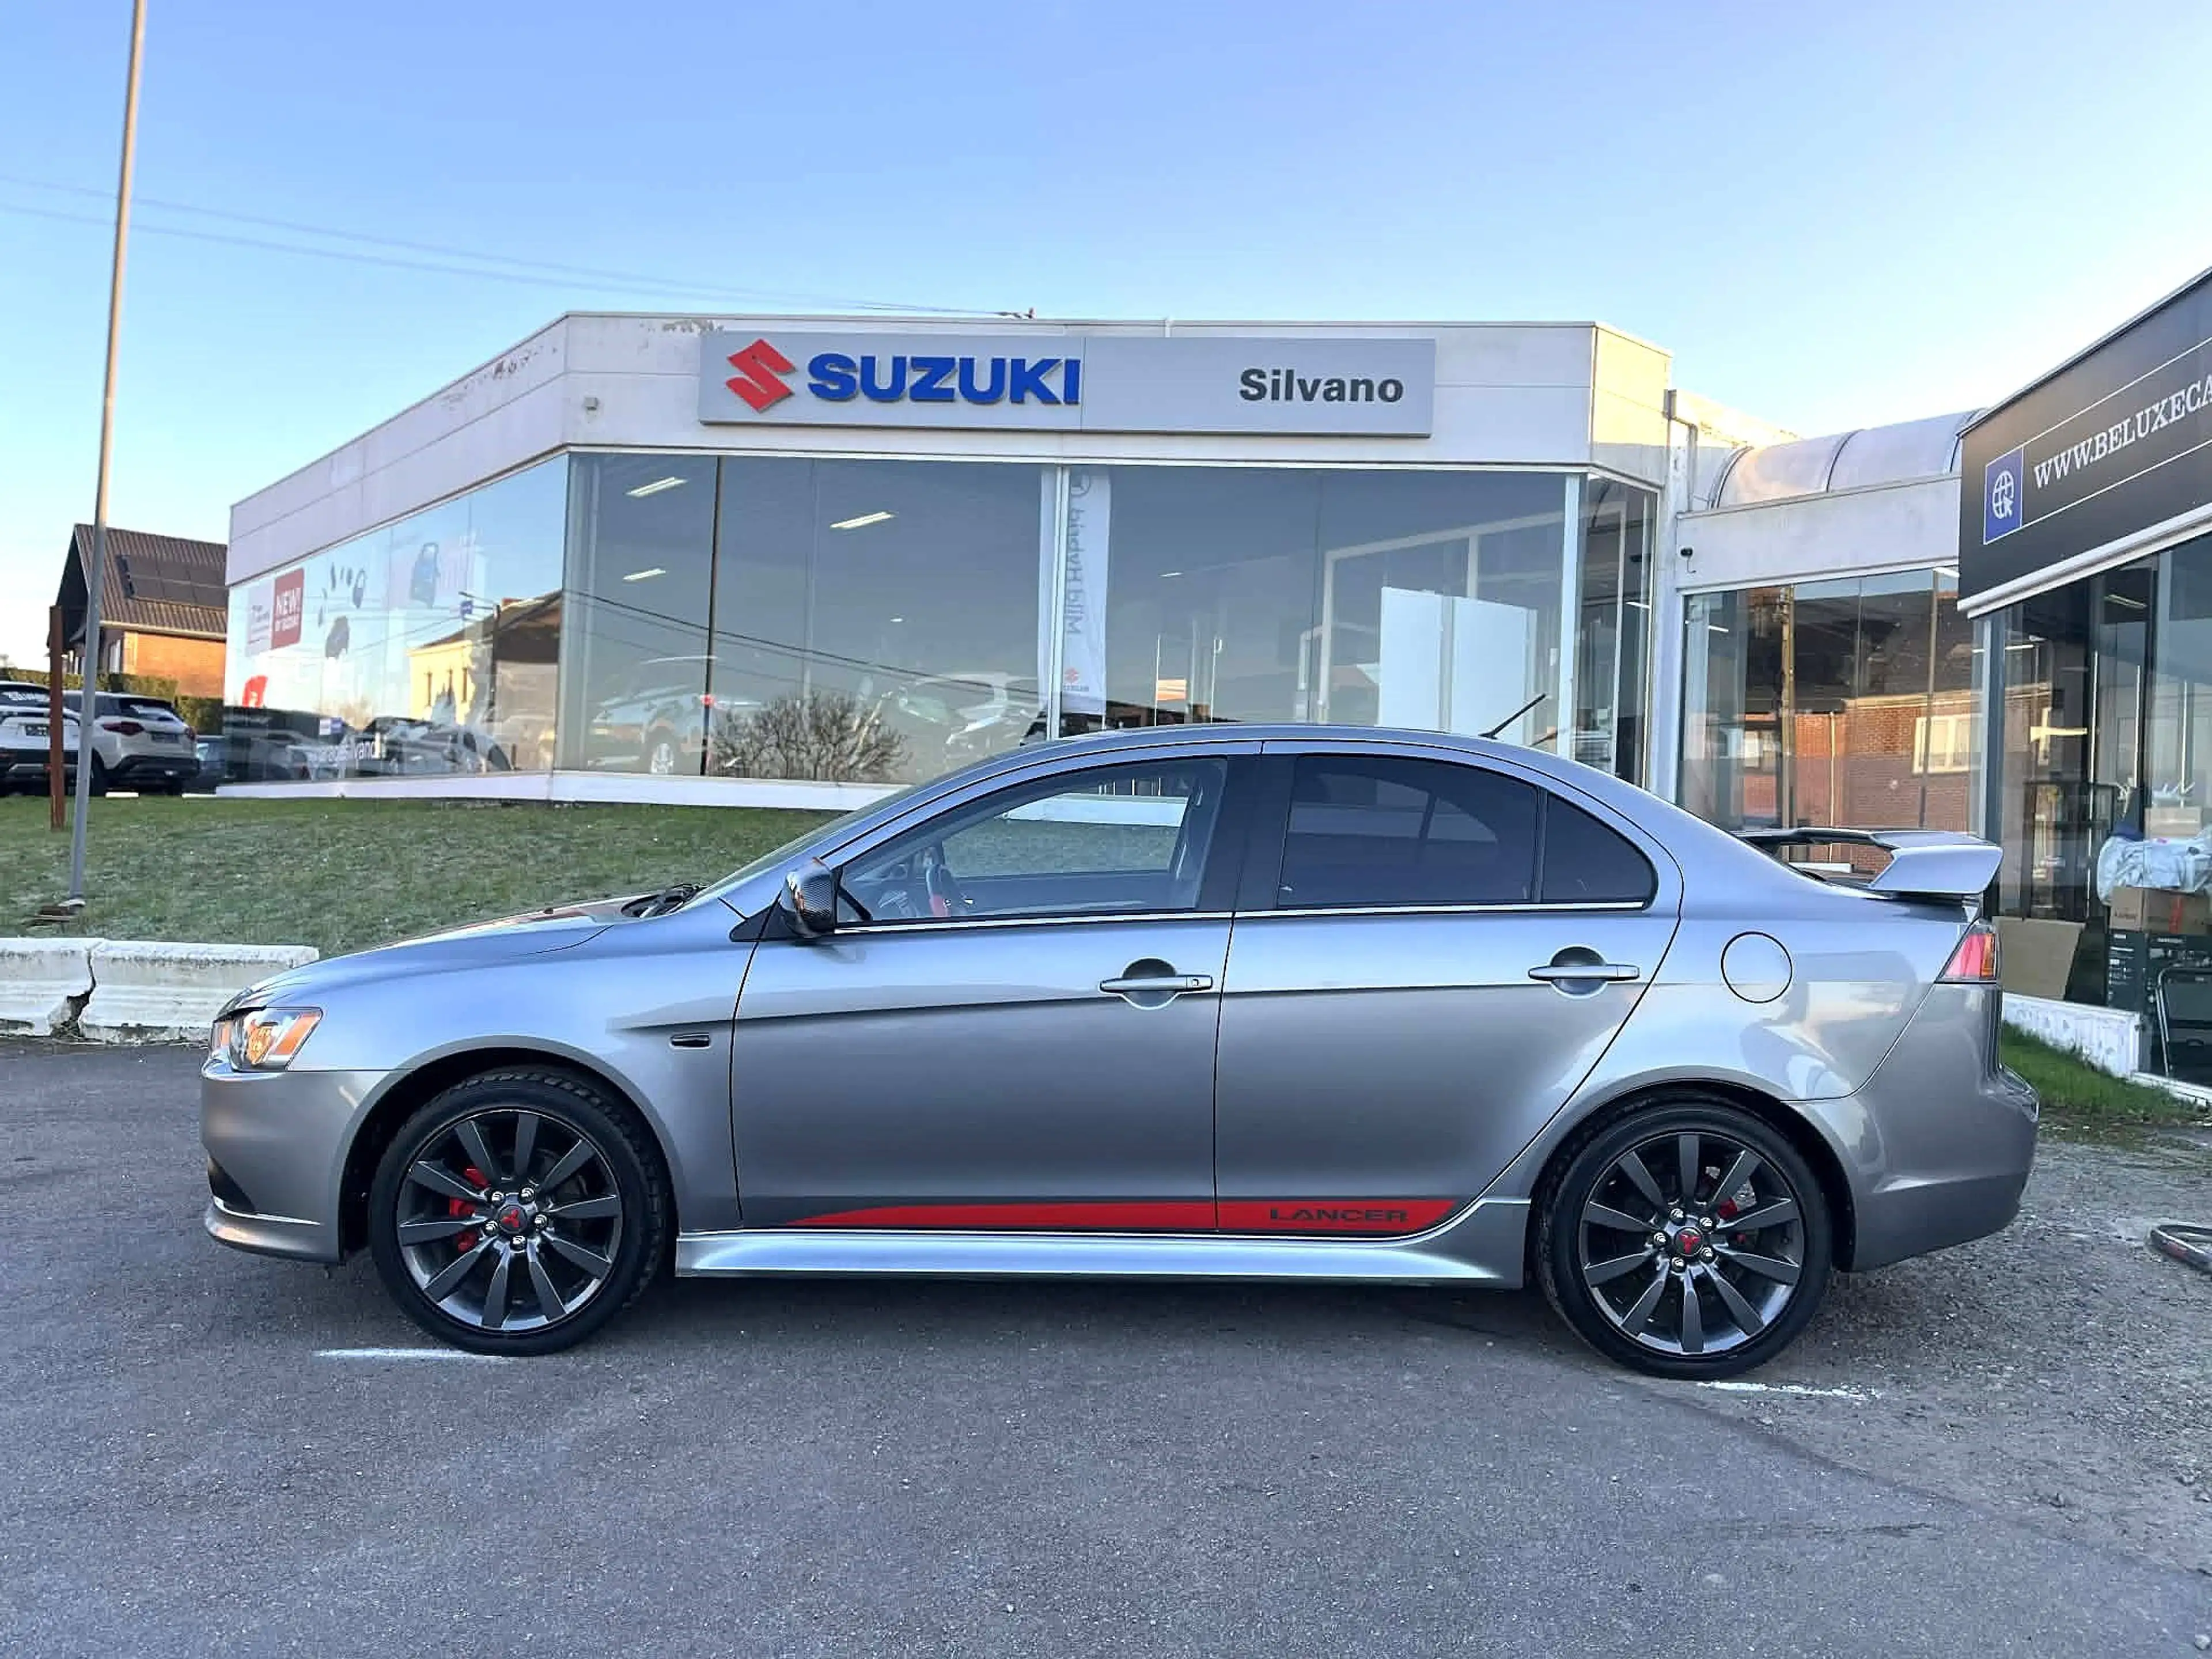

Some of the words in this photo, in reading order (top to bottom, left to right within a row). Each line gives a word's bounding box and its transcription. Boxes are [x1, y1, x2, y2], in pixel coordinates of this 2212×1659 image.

[807, 353, 1081, 404] SUZUKI
[1240, 368, 1404, 403] Silvano
[2033, 374, 2212, 489] WWW.BELUXECA
[1270, 1209, 1408, 1222] LANCER
